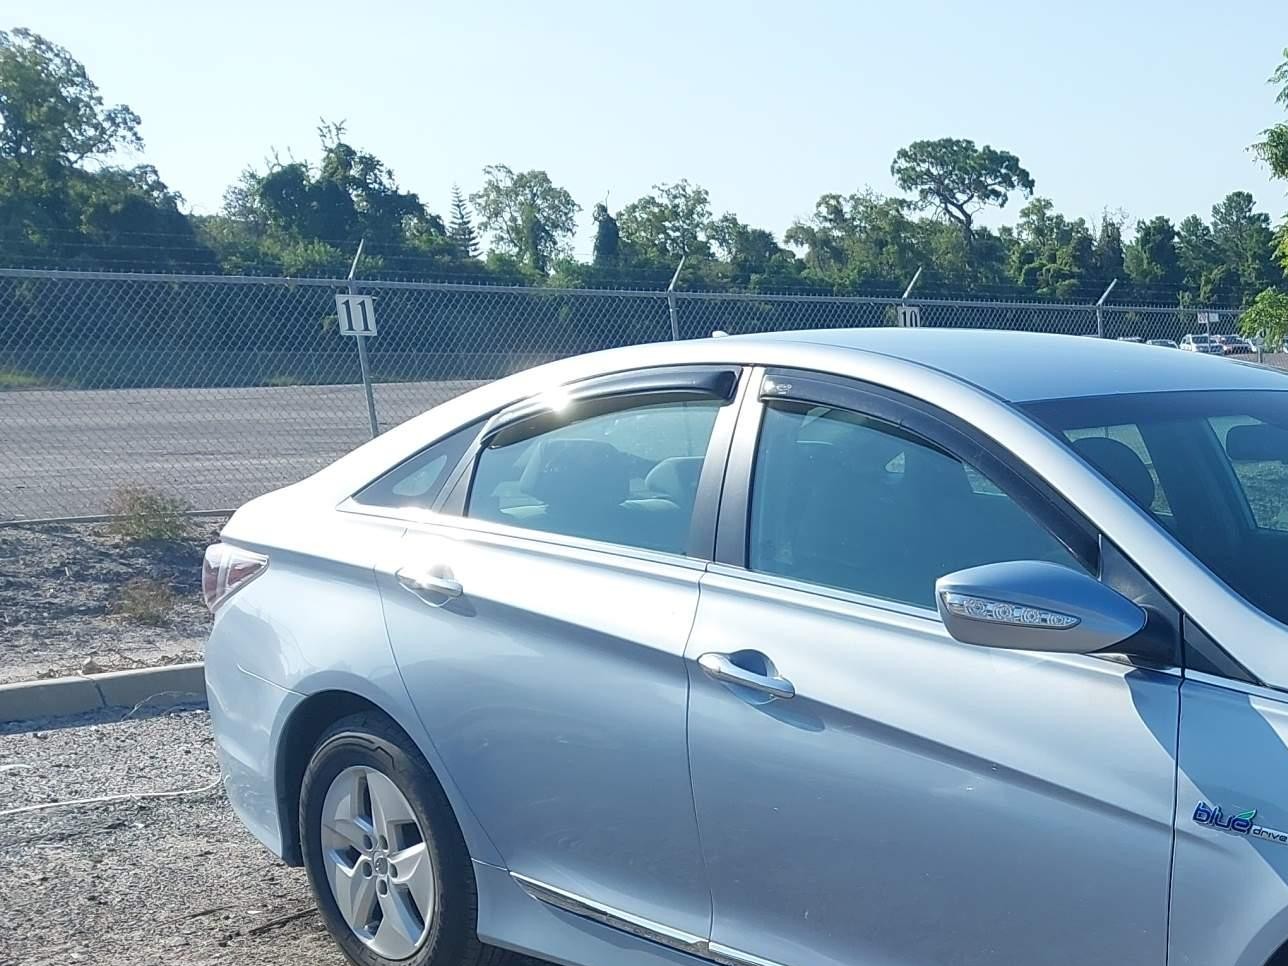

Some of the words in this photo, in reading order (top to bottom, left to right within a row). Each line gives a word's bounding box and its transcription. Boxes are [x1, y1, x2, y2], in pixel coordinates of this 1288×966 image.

[341, 299, 372, 331] 11
[1192, 801, 1253, 833] blue
[1252, 826, 1288, 843] drive
